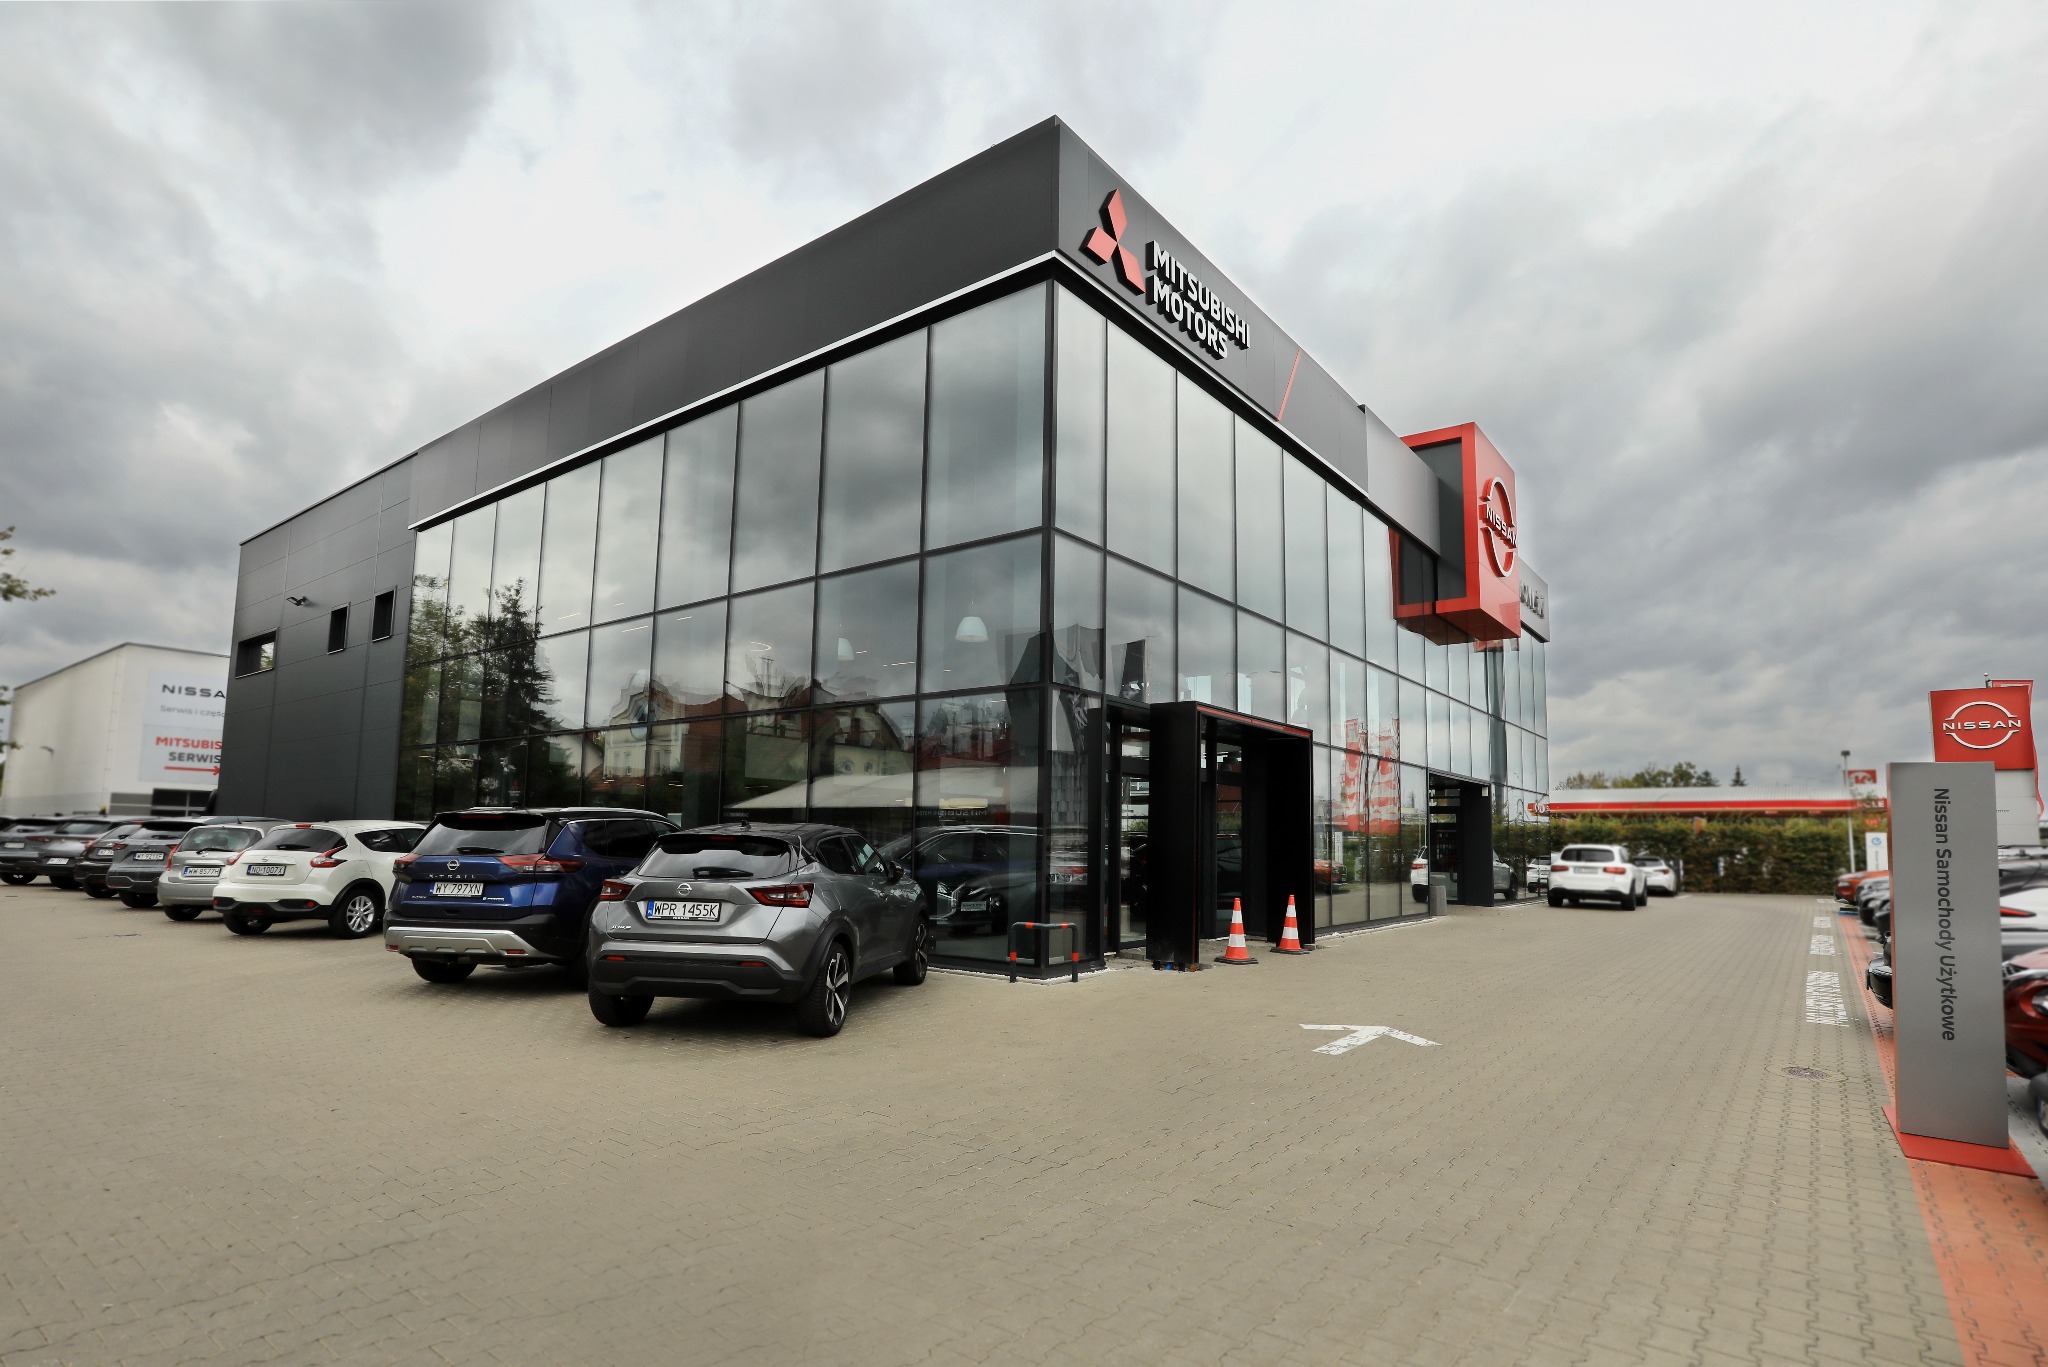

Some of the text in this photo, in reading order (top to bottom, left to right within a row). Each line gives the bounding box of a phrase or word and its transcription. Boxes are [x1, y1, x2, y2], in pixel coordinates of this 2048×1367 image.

[1151, 240, 1250, 349] MITSUBISHI
[1151, 274, 1228, 359] MOTORS
[1485, 503, 1517, 547] NISSAN
[1942, 719, 2022, 731] NISSAN
[168, 751, 222, 764] SERWIS
[435, 883, 482, 895] WY 797XN
[654, 902, 718, 917] WPR 1455K
[1934, 788, 1958, 1041] Nissan Samochody Użytkowe
